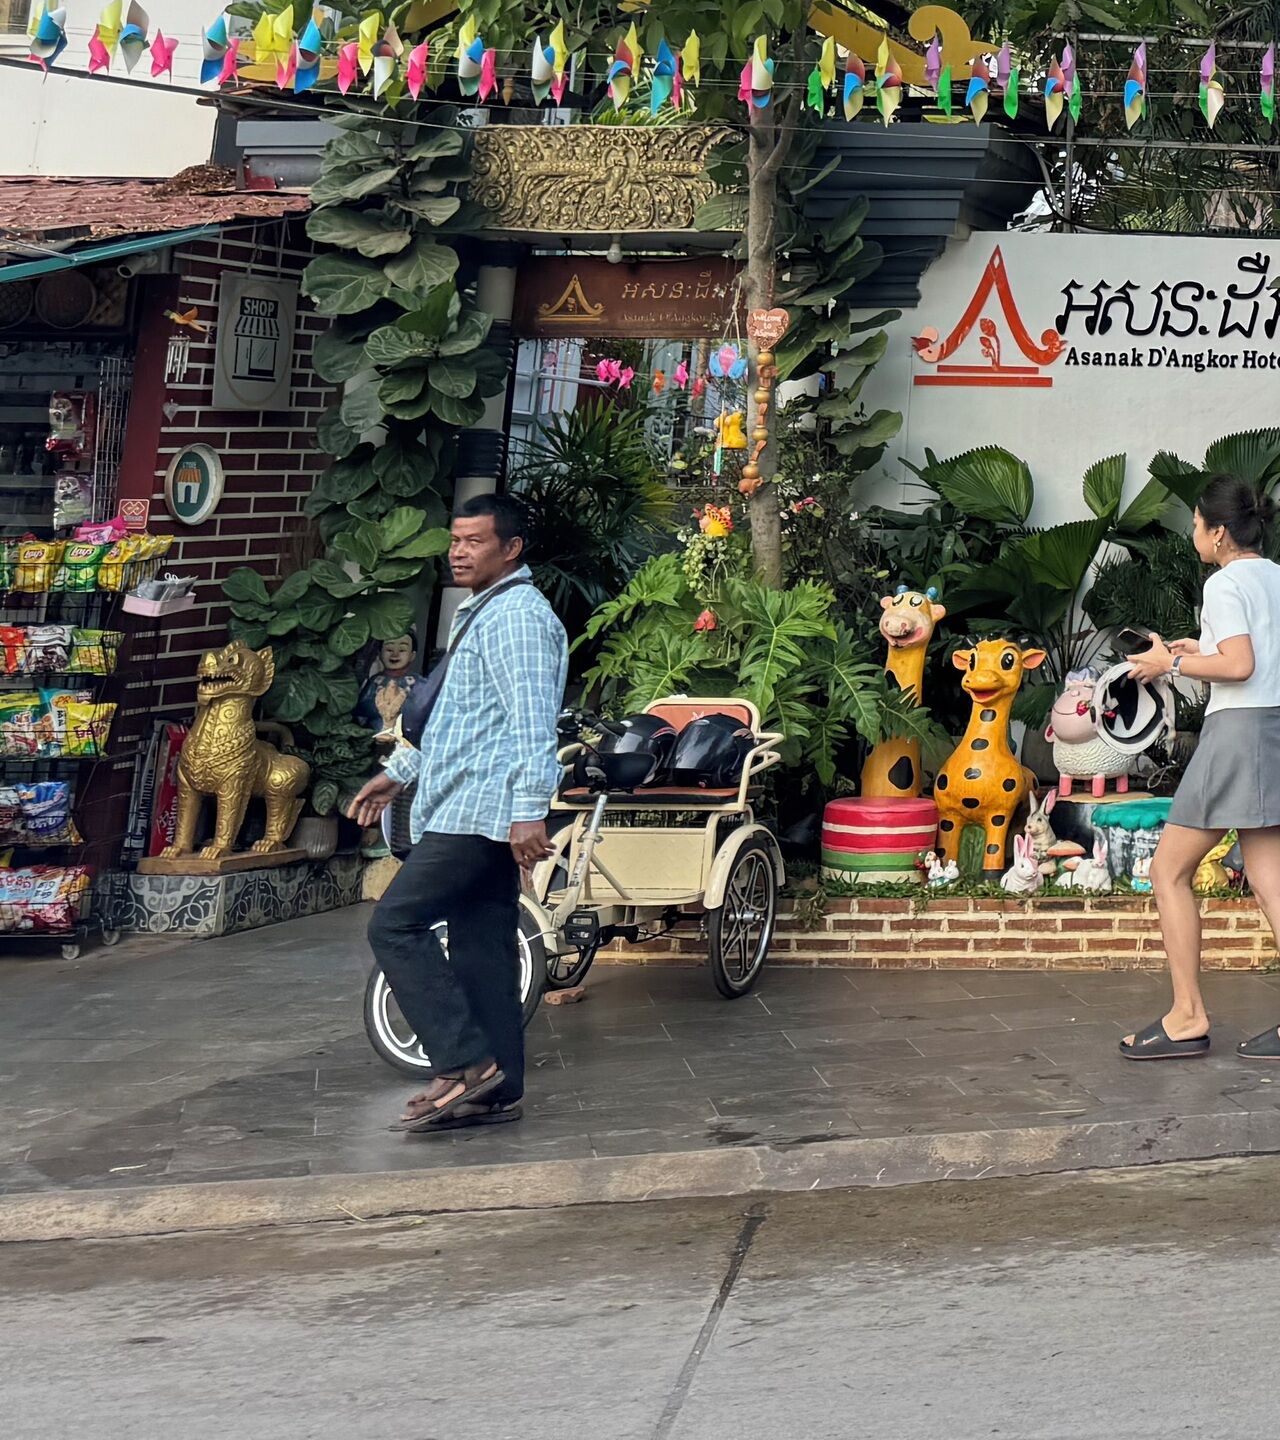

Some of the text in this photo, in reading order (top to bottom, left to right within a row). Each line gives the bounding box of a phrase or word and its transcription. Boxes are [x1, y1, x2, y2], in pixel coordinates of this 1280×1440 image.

[243, 298, 275, 317] SHOP
[1064, 346, 1144, 367] Asanak
[1147, 346, 1240, 372] D'Angkor
